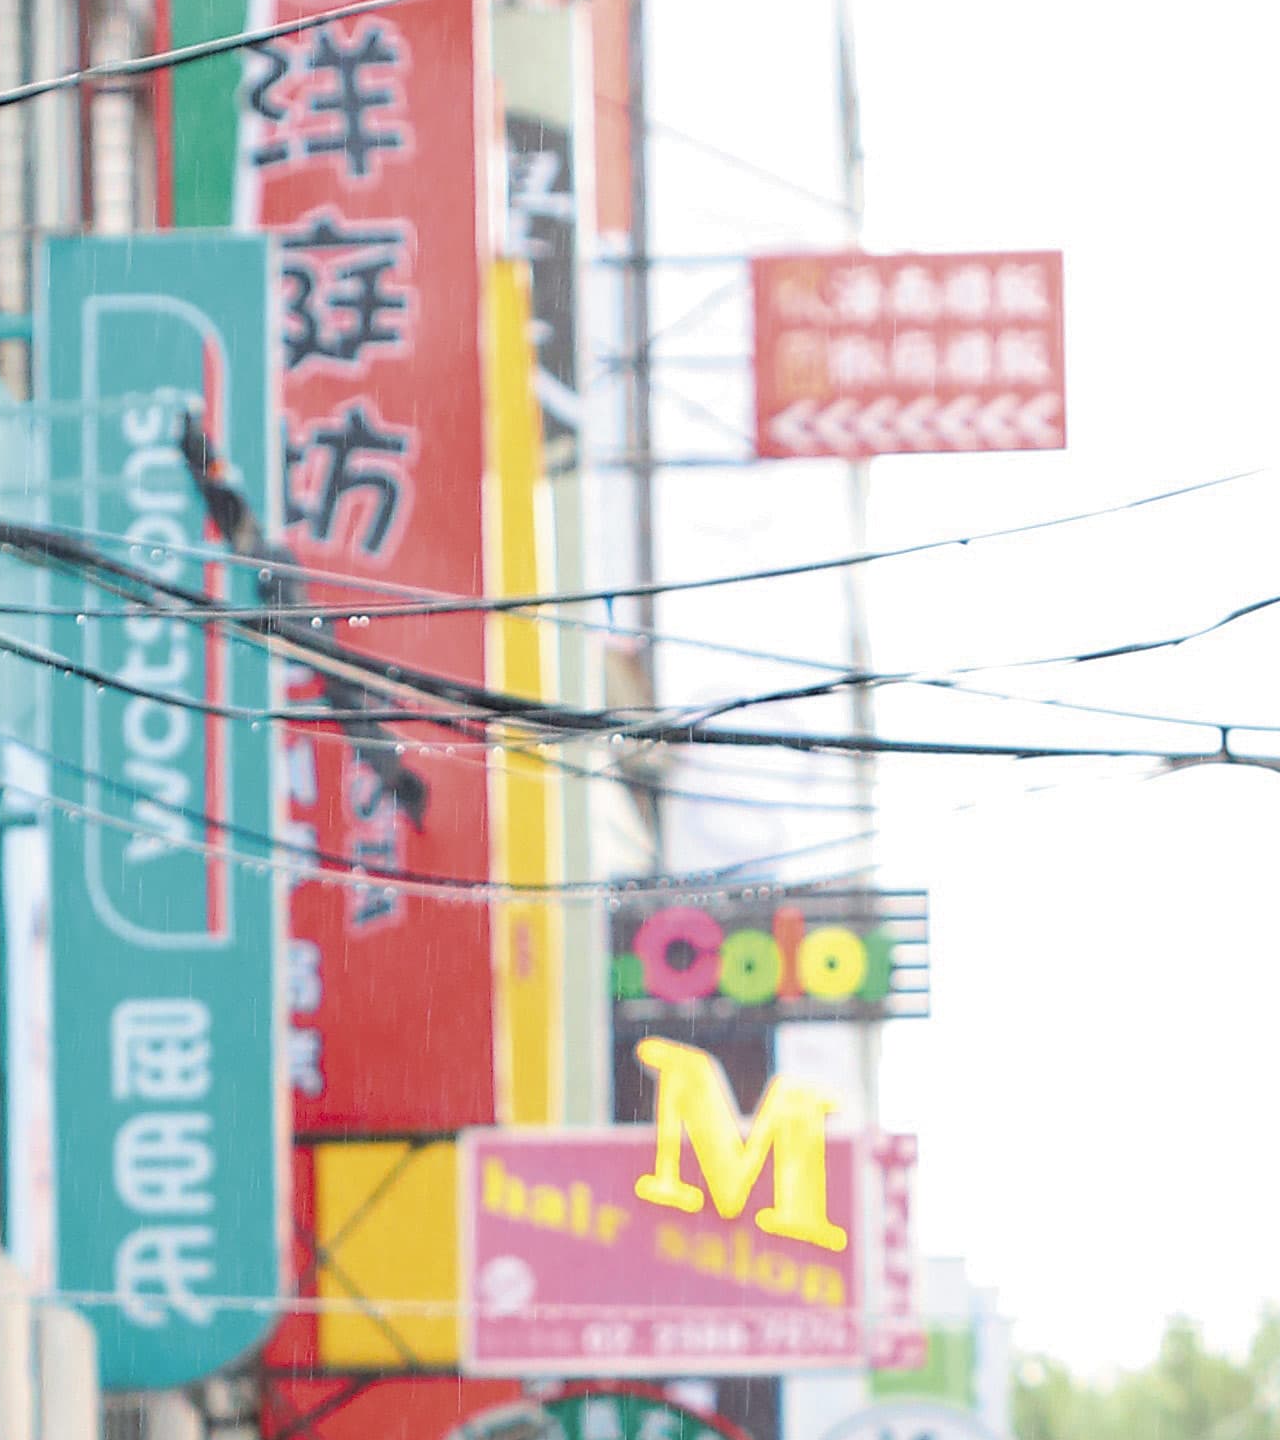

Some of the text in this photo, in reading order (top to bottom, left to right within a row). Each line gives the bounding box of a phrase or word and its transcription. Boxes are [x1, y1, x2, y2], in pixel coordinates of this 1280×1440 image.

[122, 390, 192, 864] watsons
[108, 994, 216, 1328] 屈臣氏
[482, 1157, 846, 1309] hair salon
[635, 1036, 848, 1252] M
